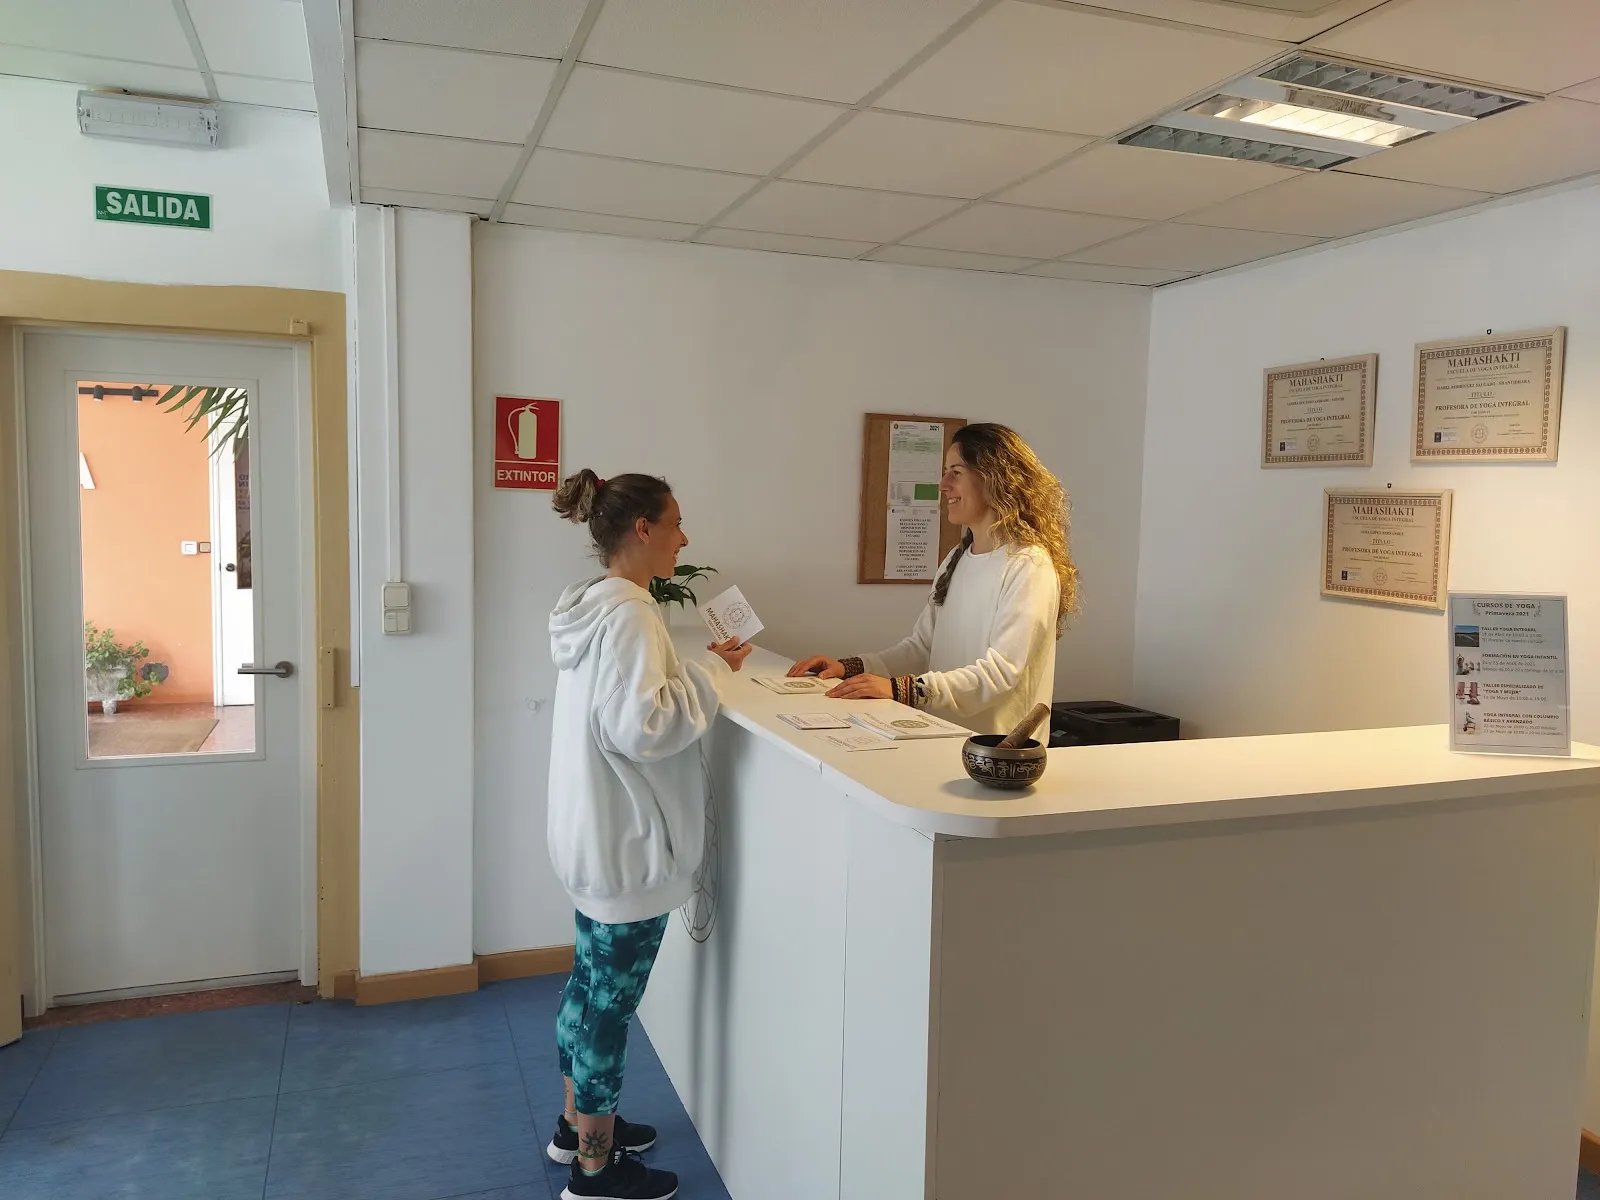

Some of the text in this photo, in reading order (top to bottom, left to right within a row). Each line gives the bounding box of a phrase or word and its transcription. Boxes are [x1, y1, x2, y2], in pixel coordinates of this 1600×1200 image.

[106, 191, 200, 221] SALIDA
[1447, 352, 1520, 368] MAHASHAKTI
[1289, 373, 1343, 388] MAHASHAKTI
[1435, 403, 1468, 411] PROFESORA
[1479, 401, 1497, 409] YOGA
[1497, 400, 1530, 408] INTEGRAL
[497, 469, 556, 483] EXTINTOR
[1352, 505, 1415, 516] MAHASHAKTI
[1395, 550, 1423, 558] INTEGRAL
[705, 607, 732, 641] MAHASHAK
